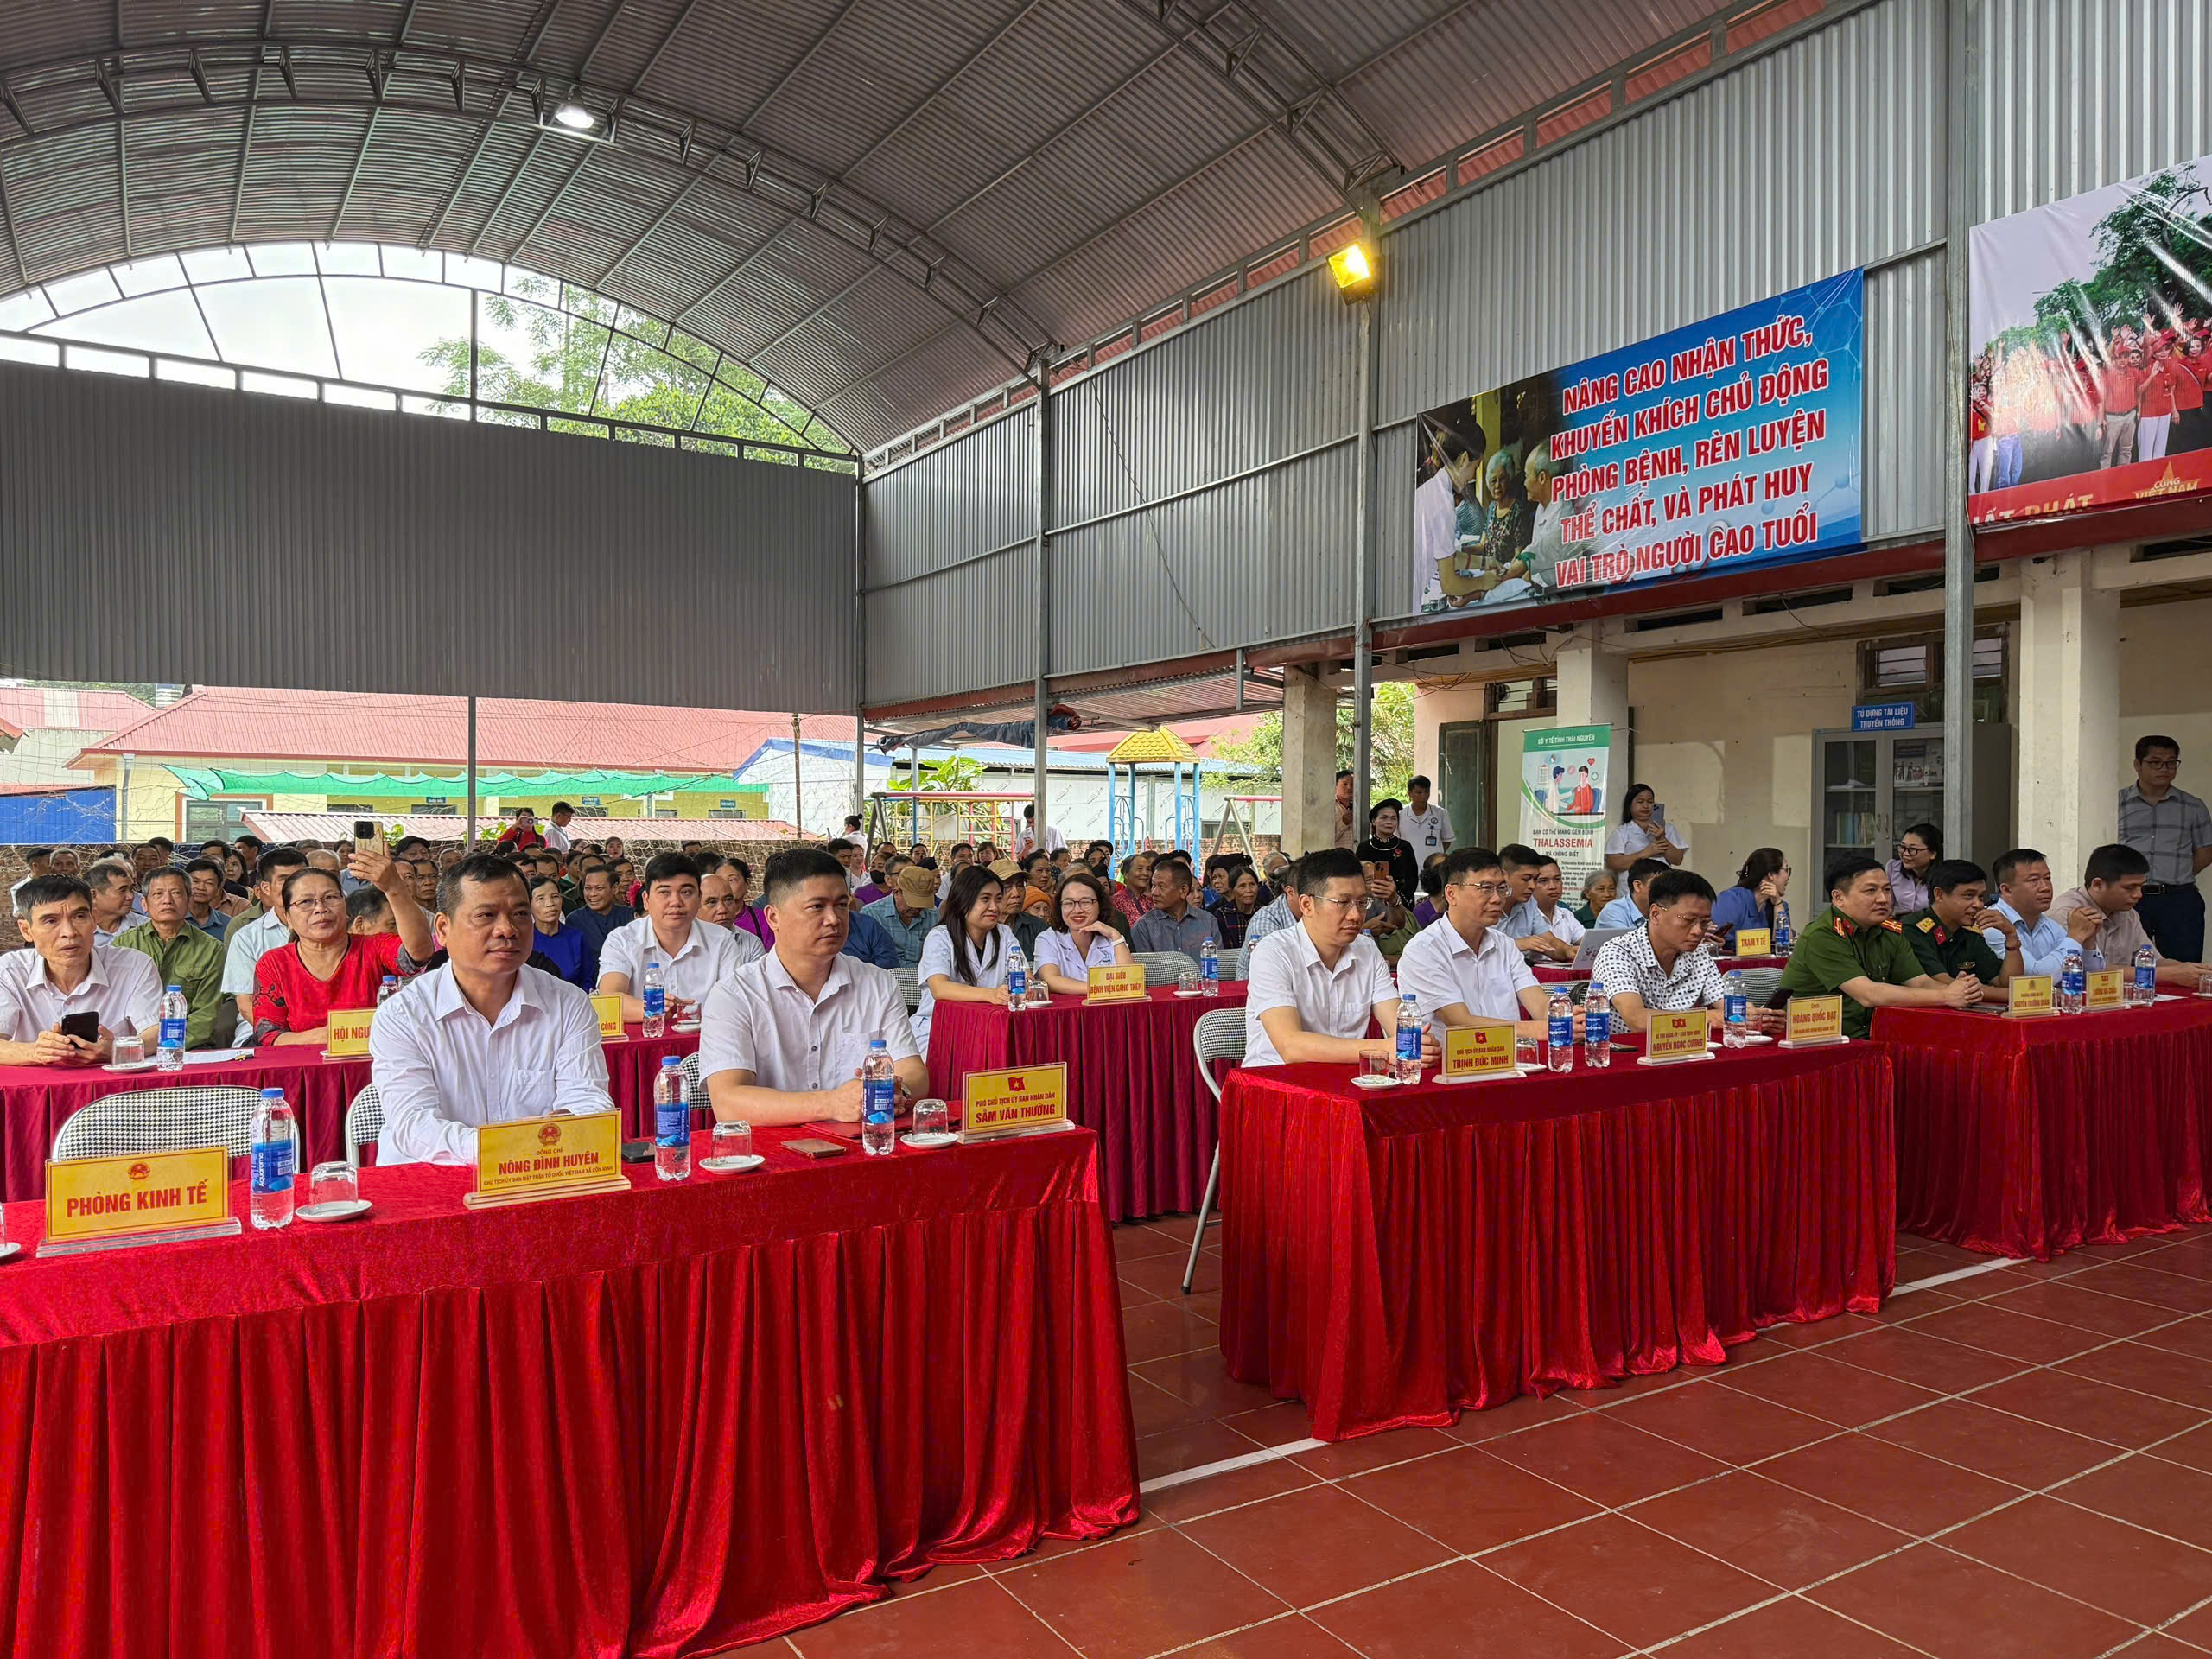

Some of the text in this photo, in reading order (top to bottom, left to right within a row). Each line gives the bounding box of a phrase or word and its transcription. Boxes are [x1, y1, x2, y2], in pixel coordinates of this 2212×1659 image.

[1563, 314, 1812, 415] NÂNG CAO NHẬN THỨC,
[1550, 359, 1828, 461] KHUYẾN KHÍCH CHỦ ĐỘNG
[1552, 408, 1826, 503] PHÒNG BỆNH, RÈN LUYỆN
[2168, 480, 2198, 493] NAM
[1560, 462, 1814, 543] THỂ CHẤT, VÀ PHÁT HUY
[1555, 501, 1818, 588] VAI TRÒ NGƯỜI CAO TUỔI
[1895, 707, 1908, 717] LIỆU
[1534, 838, 1593, 848] THALASSEMIA
[334, 1026, 371, 1042] HỘI NGƯ
[1453, 1056, 1508, 1070] TRỊNH ĐỨC MINH
[1000, 1106, 1017, 1120] VĂN
[499, 1150, 599, 1175] NÔNG ĐÌNH HUYÊN
[67, 1179, 208, 1217] PHÒNG KINH TẾ
